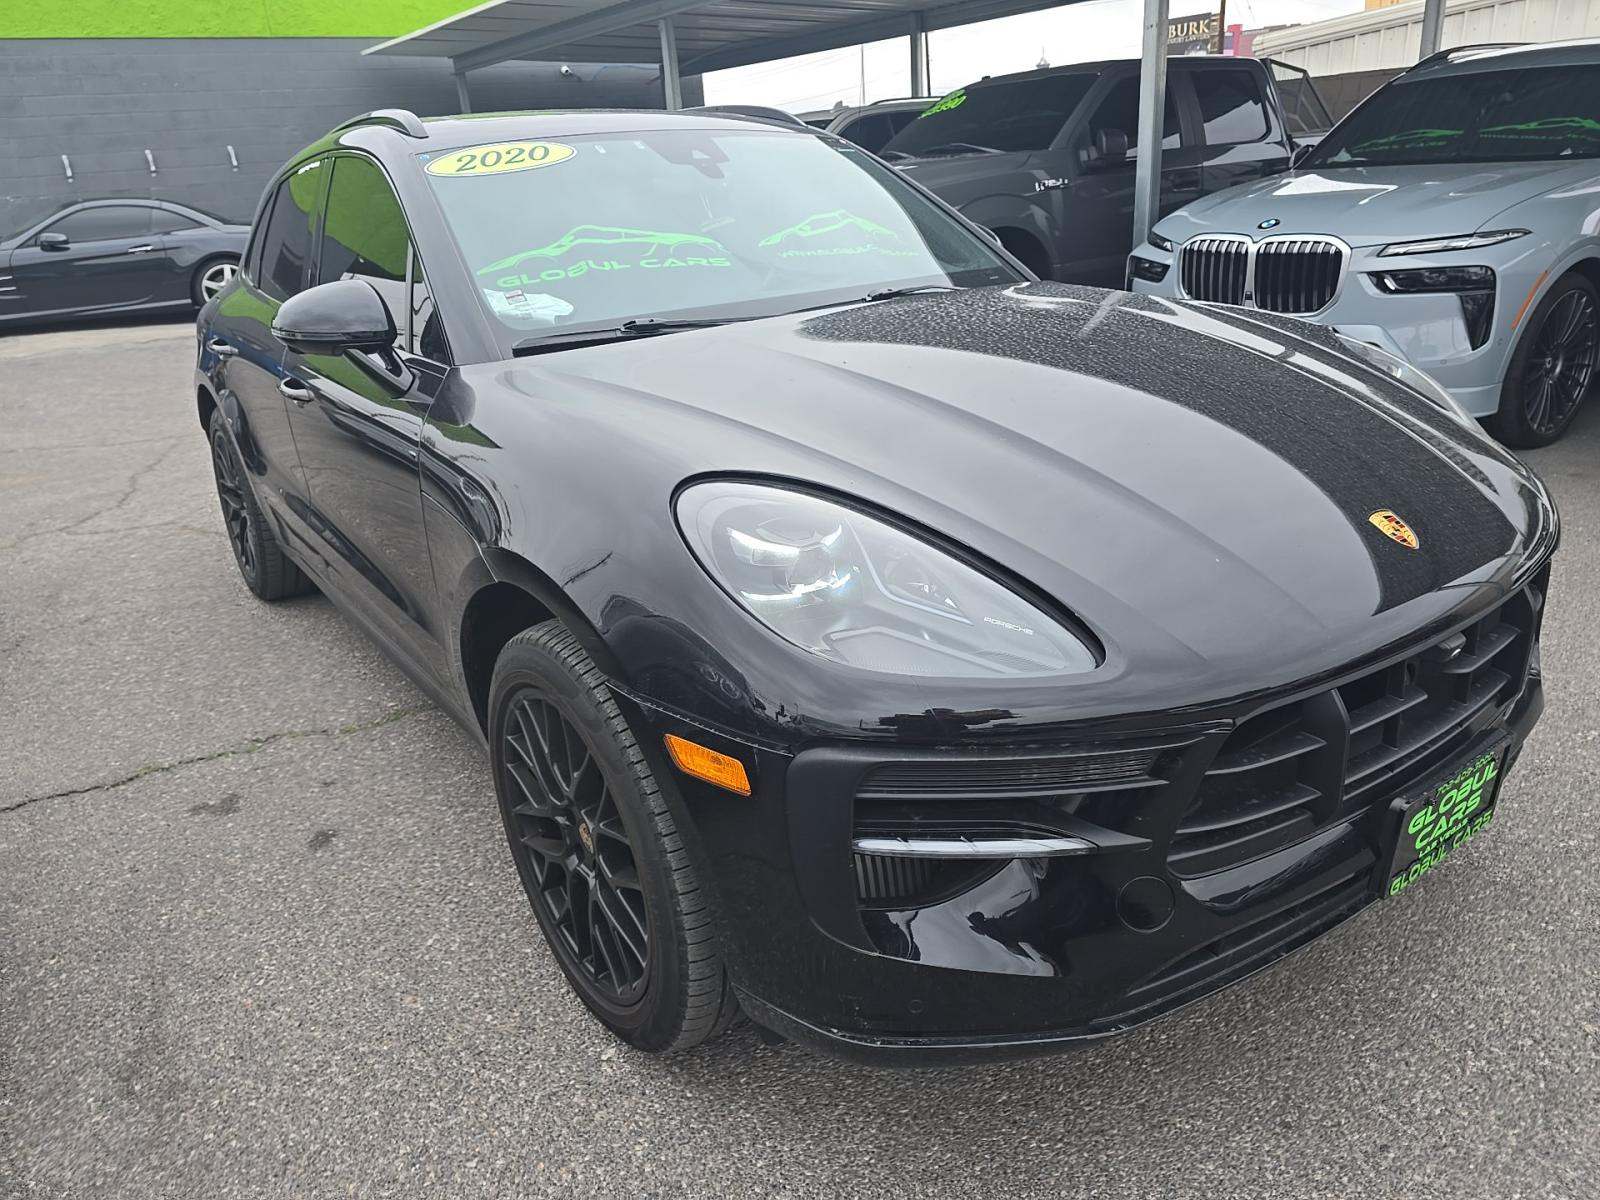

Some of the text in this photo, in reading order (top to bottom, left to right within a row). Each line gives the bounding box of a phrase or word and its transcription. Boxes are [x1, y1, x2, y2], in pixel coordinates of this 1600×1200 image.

[1168, 19, 1210, 39] BURK
[456, 145, 550, 173] 2020
[497, 257, 732, 288] GLOBUL CARS
[1408, 761, 1499, 835] GLOBUL
[1415, 788, 1483, 850] CARS
[1390, 810, 1493, 896] GLOBUL CARS
